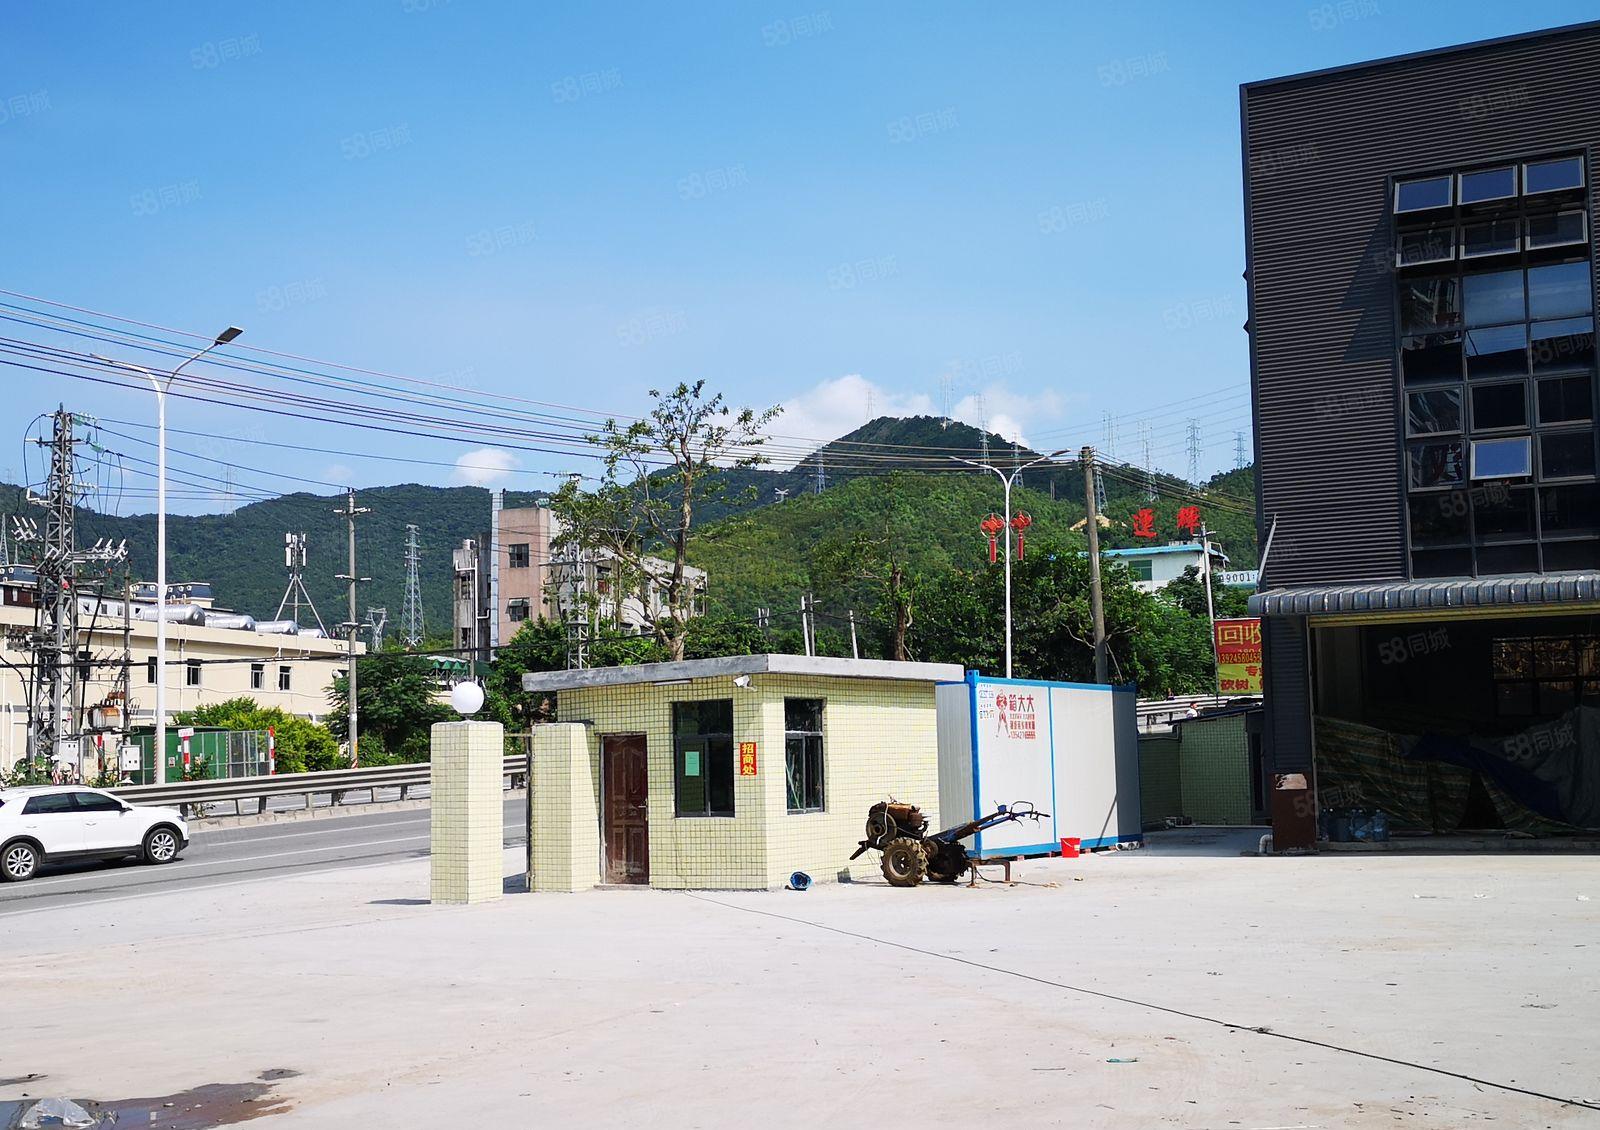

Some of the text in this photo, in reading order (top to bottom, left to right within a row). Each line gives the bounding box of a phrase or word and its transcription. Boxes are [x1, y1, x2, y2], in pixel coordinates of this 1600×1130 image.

[1218, 622, 1262, 646] 回收
[741, 743, 755, 775] 招商处
